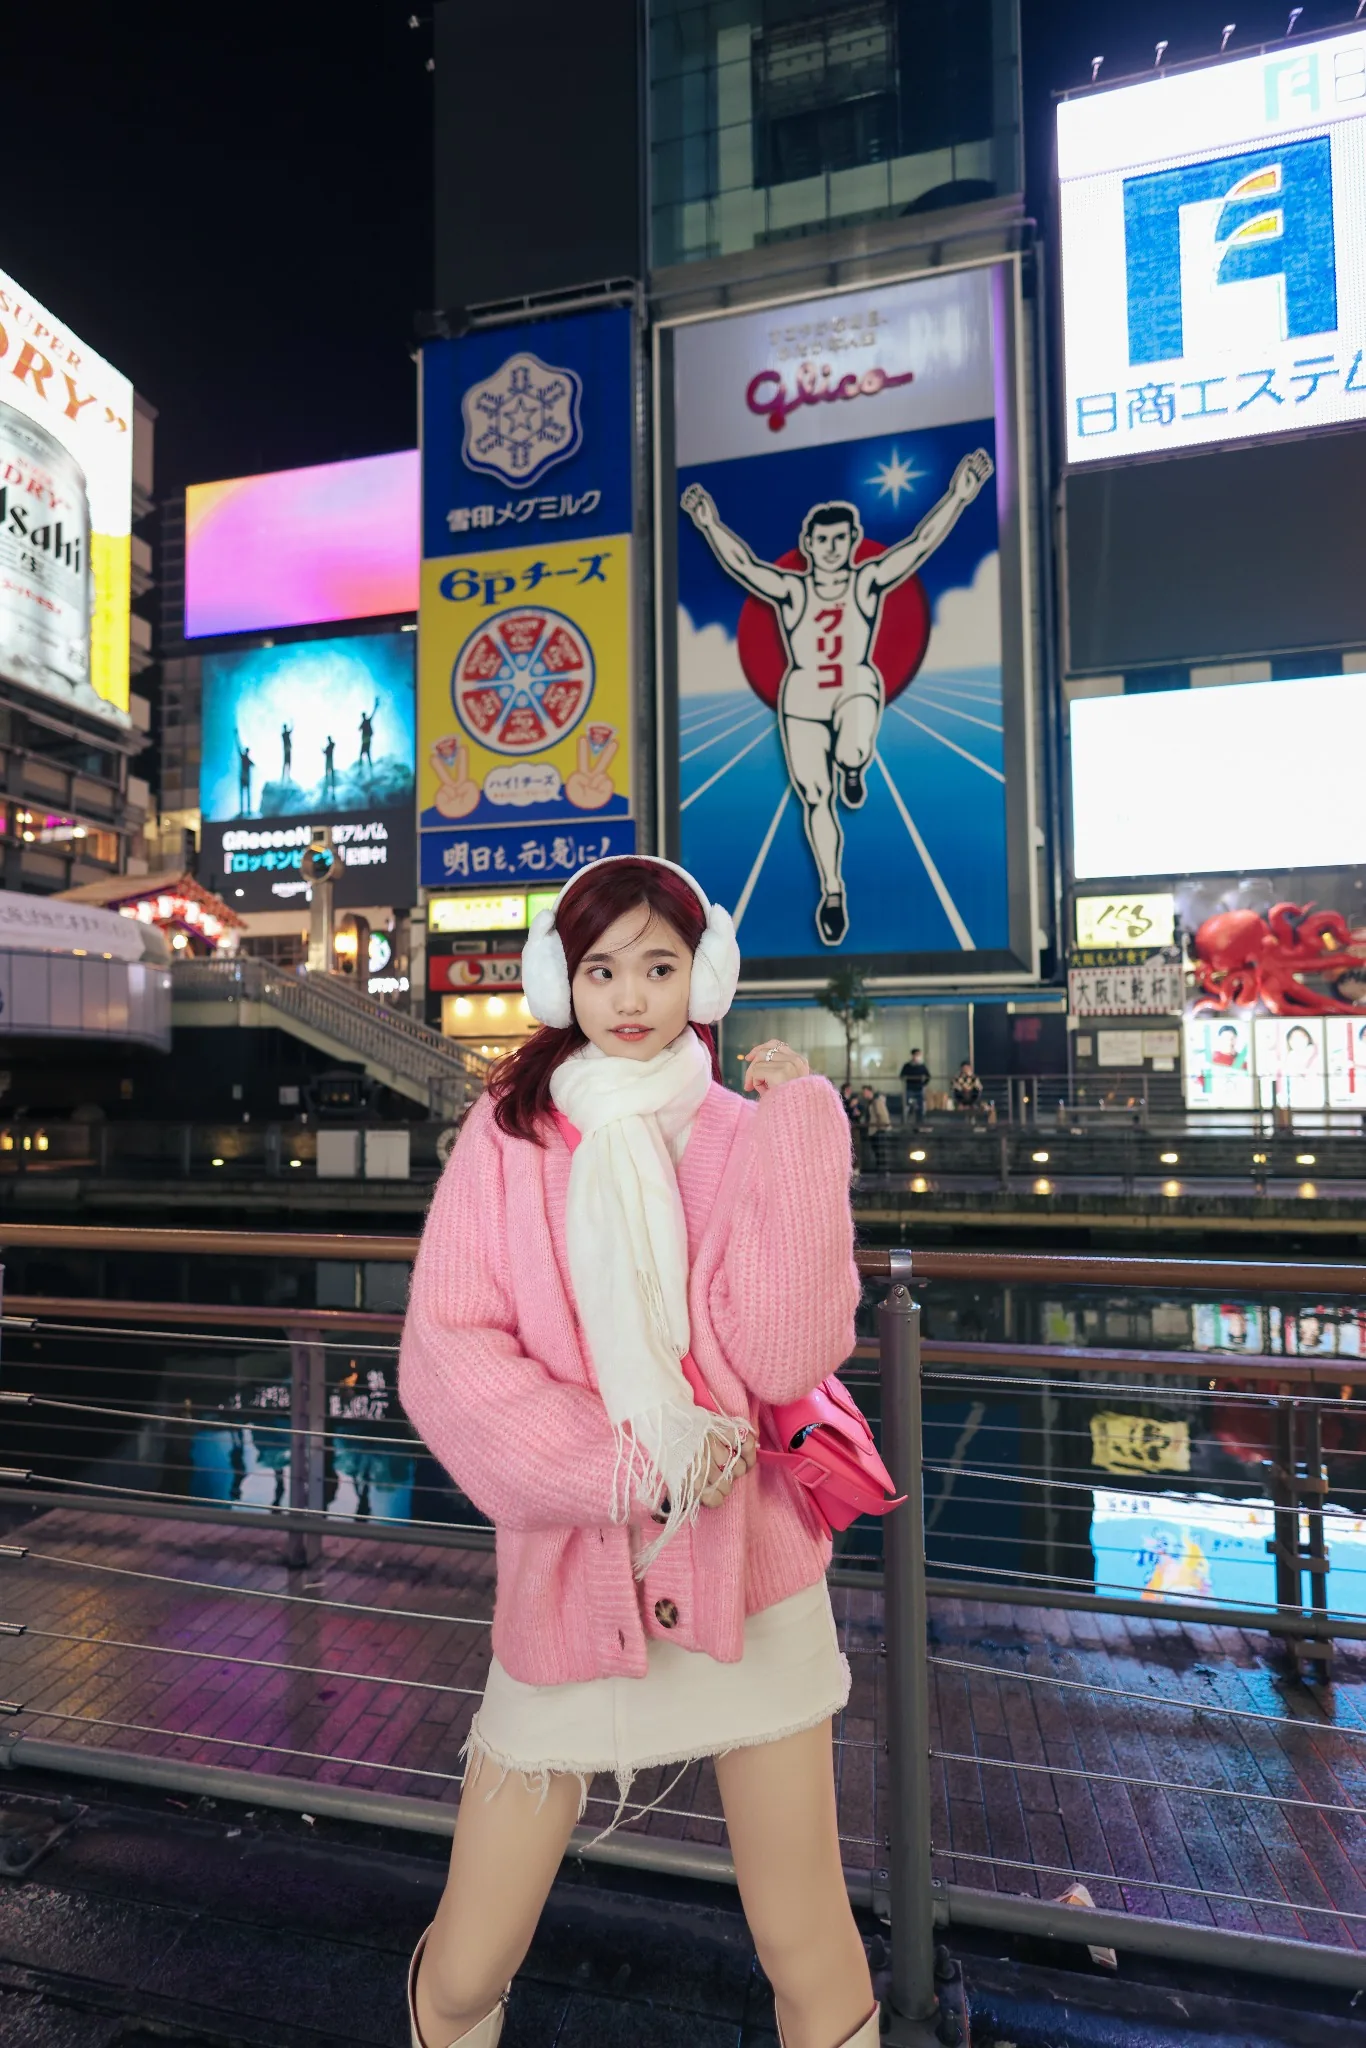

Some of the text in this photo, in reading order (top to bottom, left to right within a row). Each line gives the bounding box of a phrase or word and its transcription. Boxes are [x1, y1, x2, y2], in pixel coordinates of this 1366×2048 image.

[745, 364, 914, 432] Glico
[0, 486, 80, 574] sahi
[446, 489, 602, 533] 雪印メグミルク
